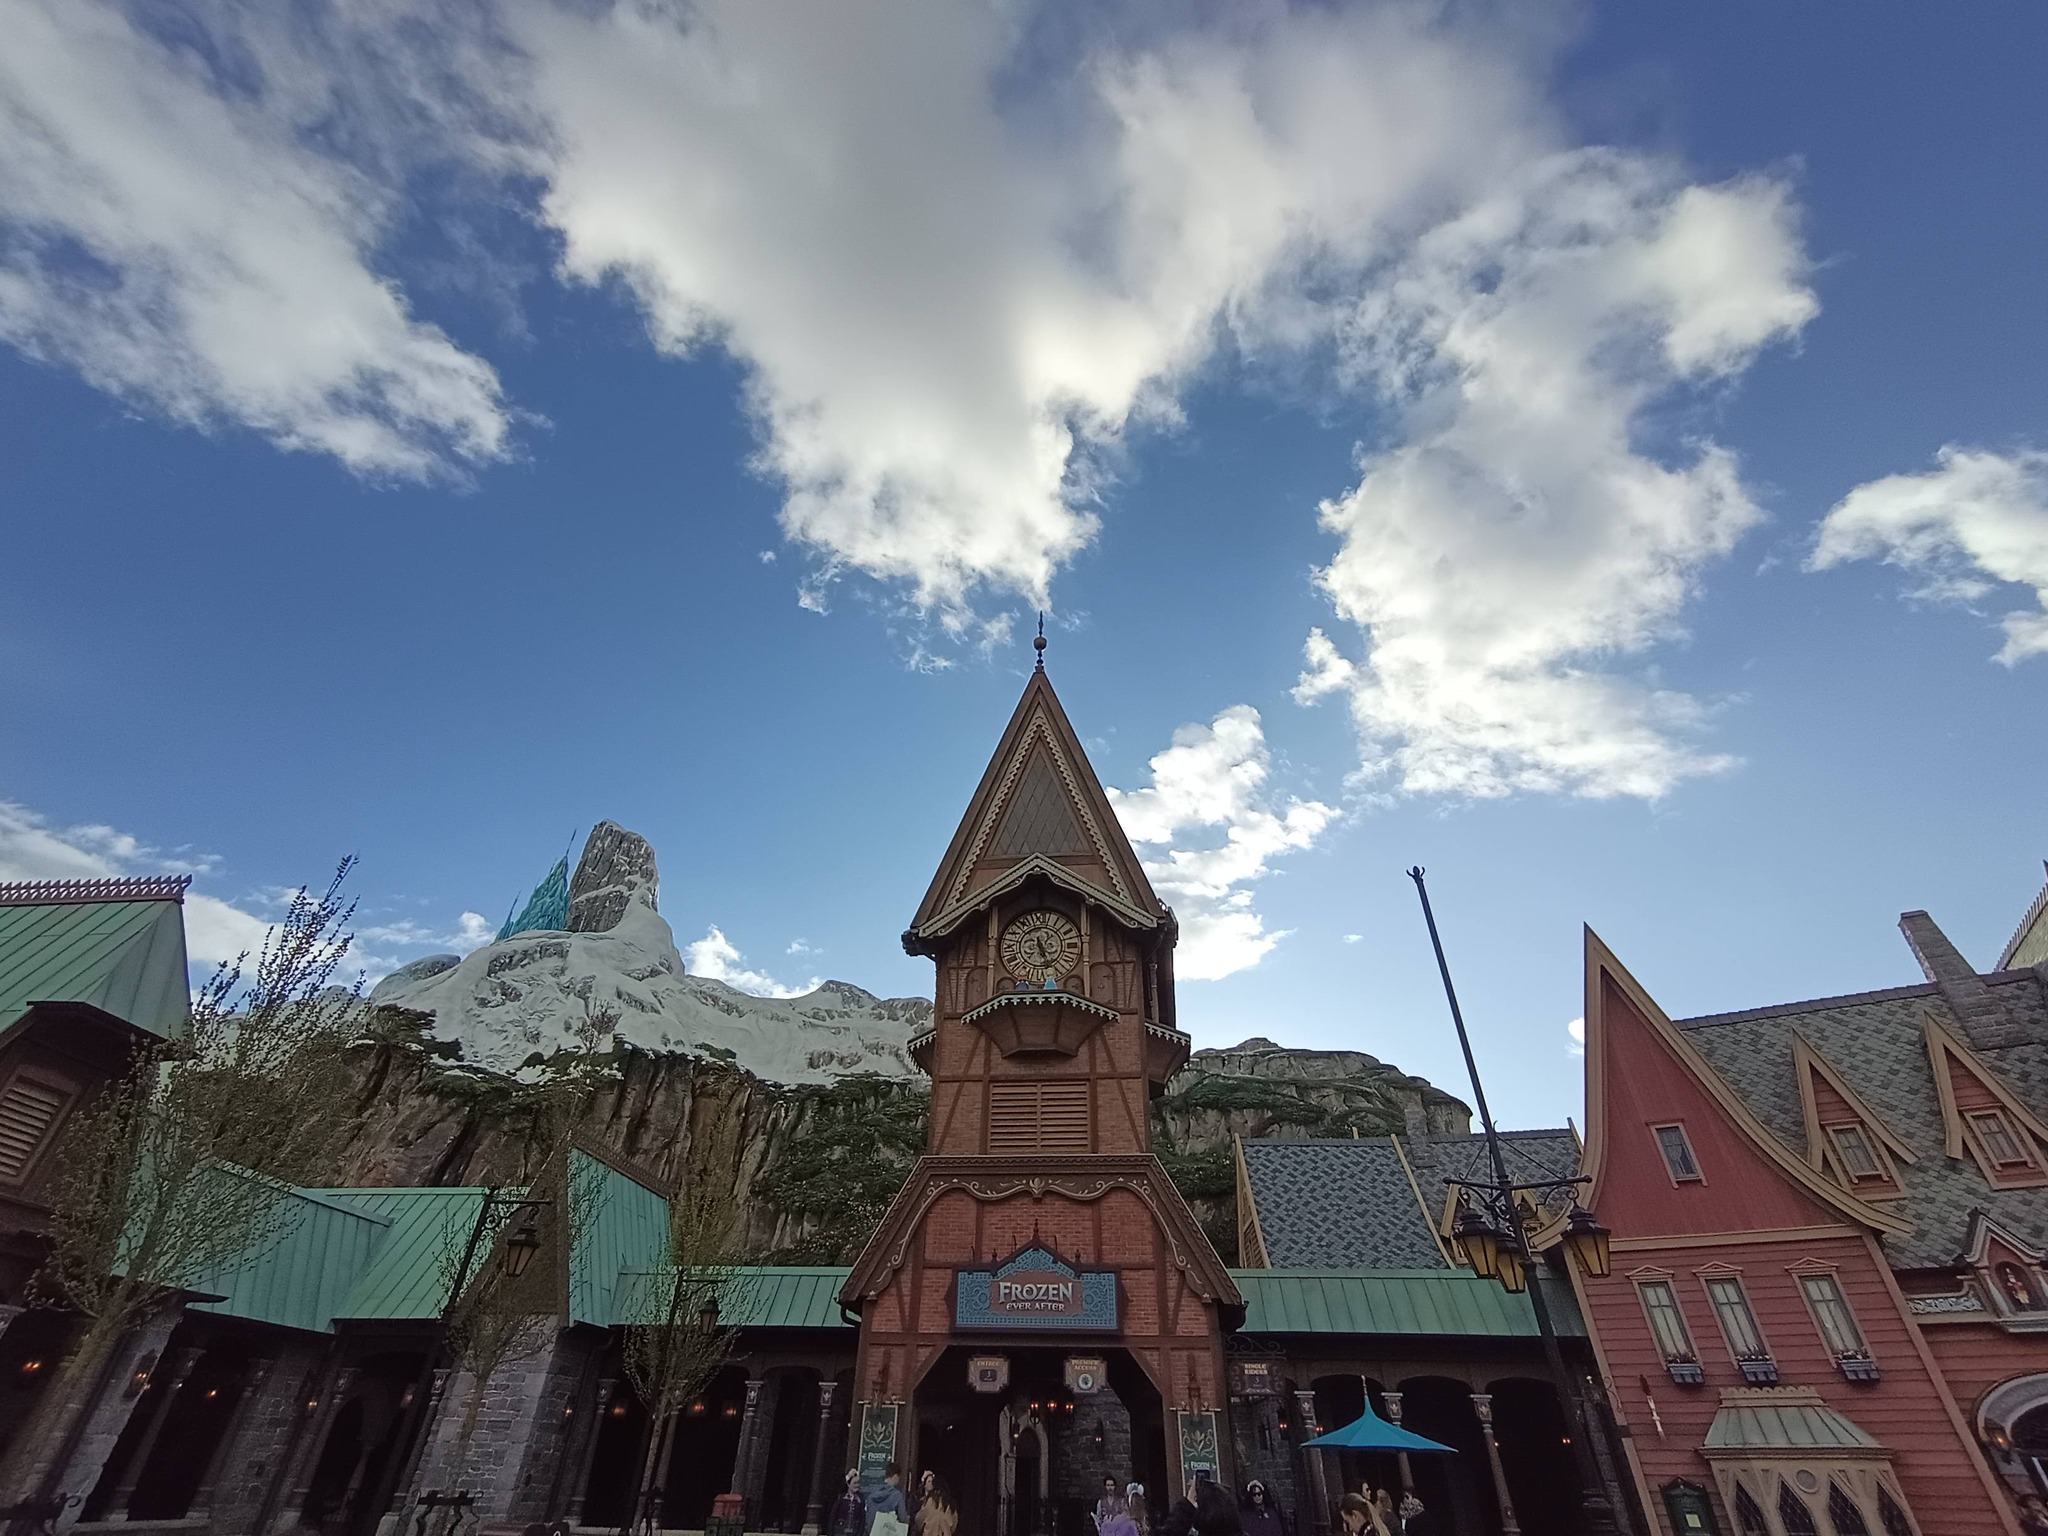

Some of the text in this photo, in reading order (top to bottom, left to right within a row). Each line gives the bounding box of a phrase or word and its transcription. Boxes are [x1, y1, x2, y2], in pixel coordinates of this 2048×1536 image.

[999, 1282, 1073, 1304] FROZEN
[1006, 1302, 1065, 1312] EVER AFTER
